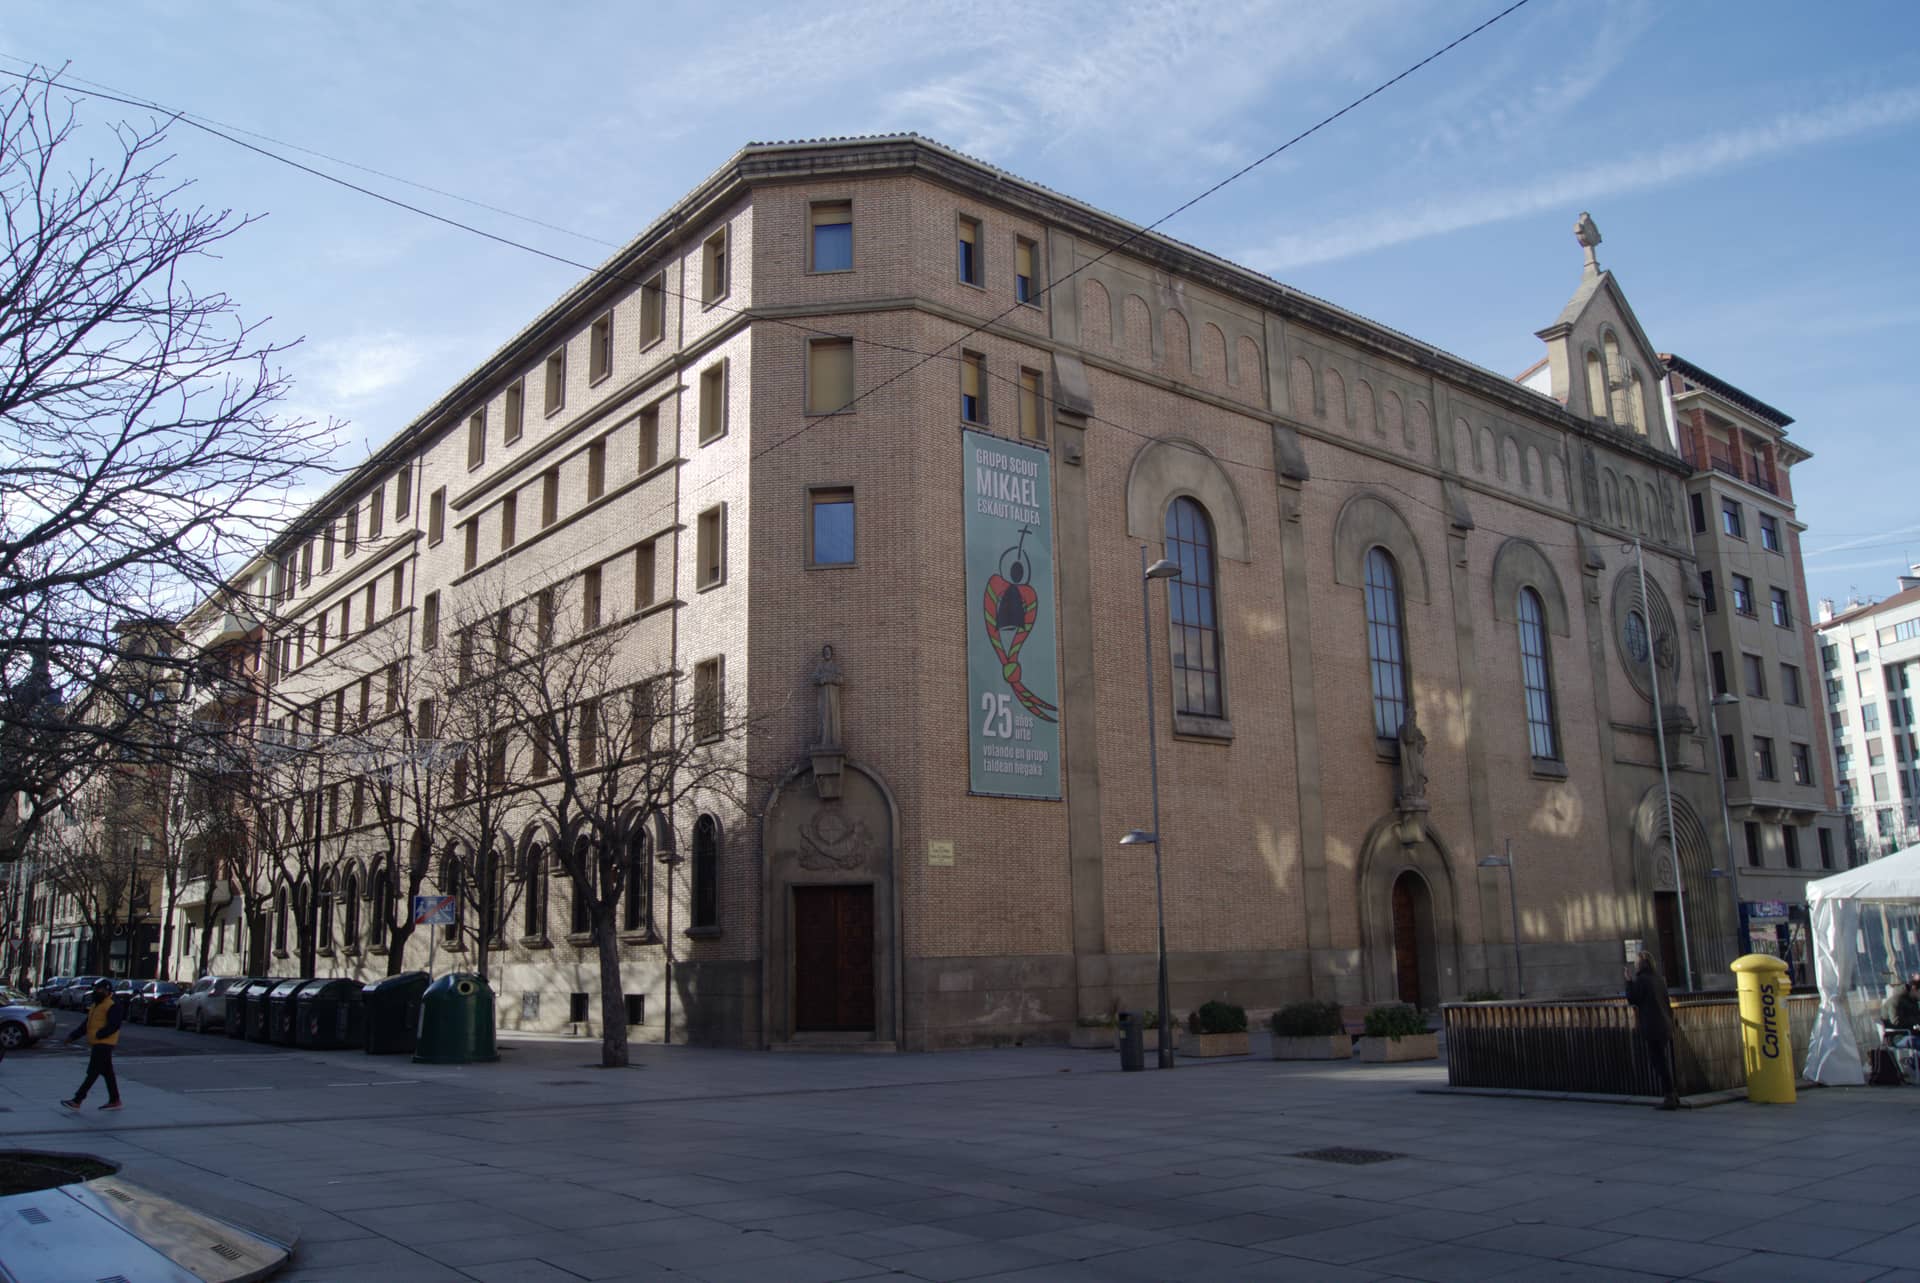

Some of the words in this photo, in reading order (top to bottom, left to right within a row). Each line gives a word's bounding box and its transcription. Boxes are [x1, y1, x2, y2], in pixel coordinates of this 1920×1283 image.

[976, 448, 1008, 470] GRUPO
[1009, 456, 1038, 478] SCOUT
[976, 466, 1040, 508] MIKAEL
[977, 497, 1009, 519] ESKAUT
[1010, 505, 1041, 526] TALDEA
[981, 691, 1012, 739] 25
[1015, 727, 1032, 741] urte
[983, 743, 1014, 758] volando
[1015, 747, 1025, 760] en
[1026, 749, 1049, 762] grupo
[983, 758, 1014, 774] taldean
[1014, 762, 1043, 777] hegaka
[1761, 983, 1780, 1059] Correos
